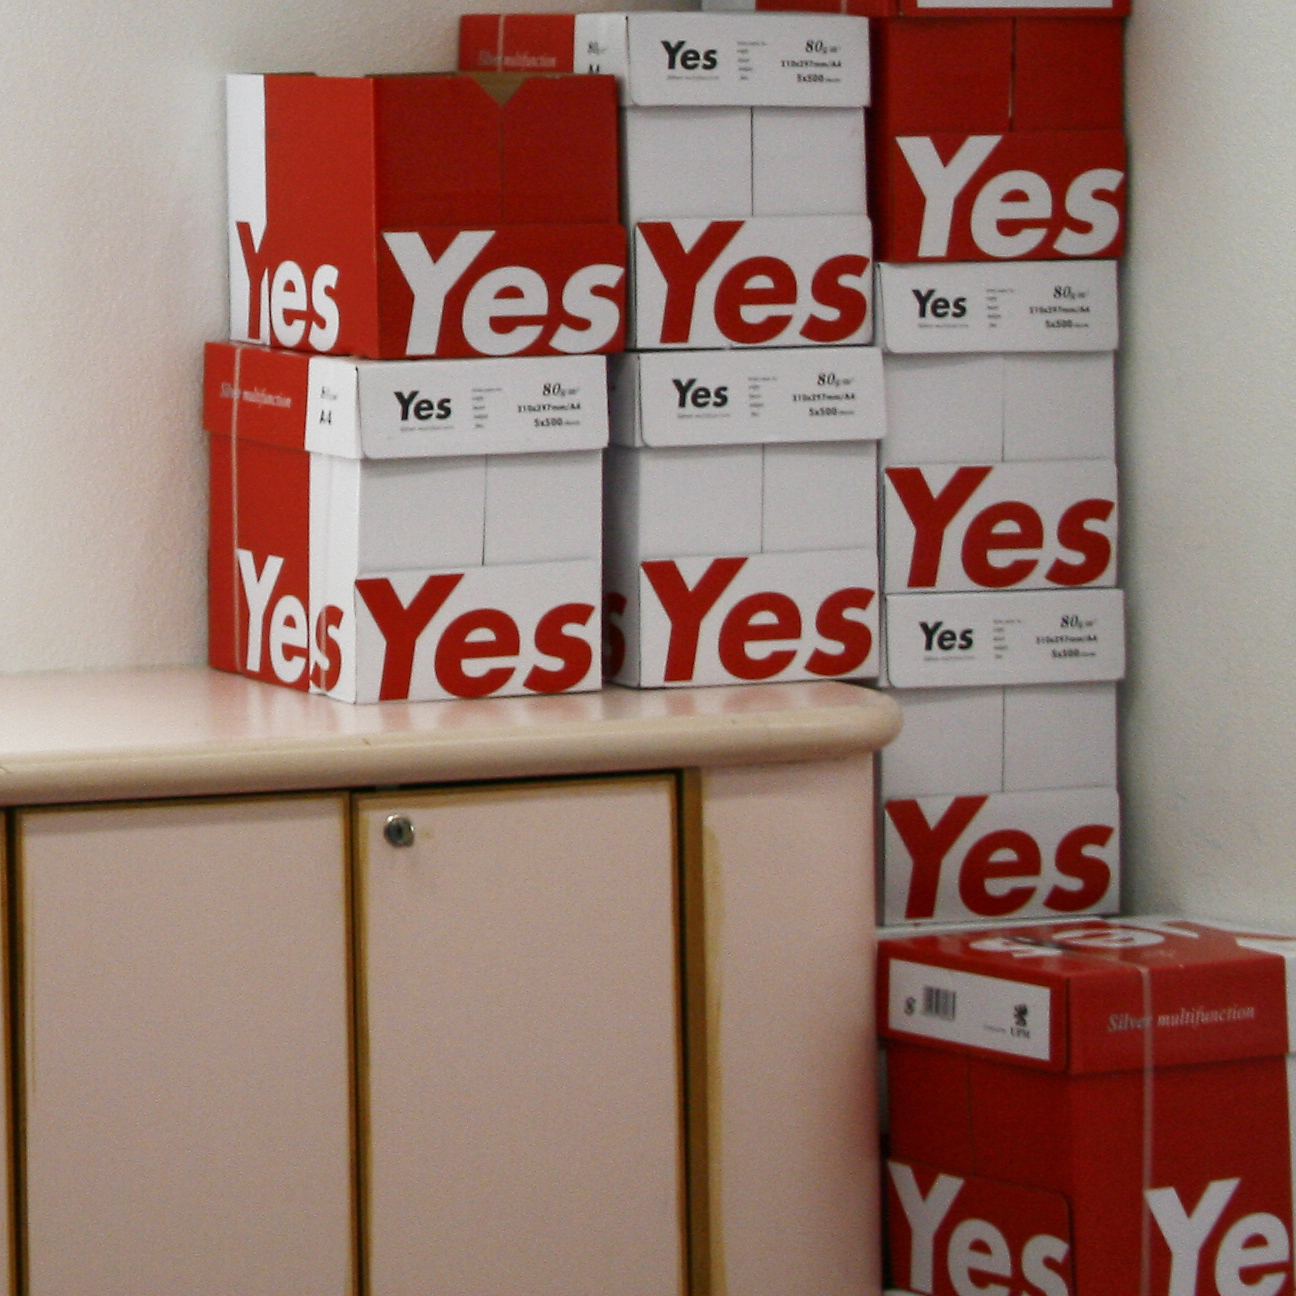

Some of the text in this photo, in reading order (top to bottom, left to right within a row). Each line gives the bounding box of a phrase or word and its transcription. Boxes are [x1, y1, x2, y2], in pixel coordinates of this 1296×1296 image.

[661, 40, 718, 70] Yes
[895, 135, 1124, 257] Yes
[236, 221, 340, 352] Yes
[383, 230, 624, 356] Yes
[636, 220, 870, 344] Yes
[912, 289, 967, 319] Yes
[394, 390, 451, 421] Yes
[672, 378, 729, 408] Yes
[885, 465, 1115, 588] Yes
[237, 548, 344, 694] Yes
[355, 574, 596, 701] Yes
[641, 557, 875, 682] Yes
[919, 621, 974, 651] Yes
[885, 795, 1114, 918] Yes
[1109, 1004, 1255, 1032] Silver multifunction
[887, 1161, 1070, 1296] Yes
